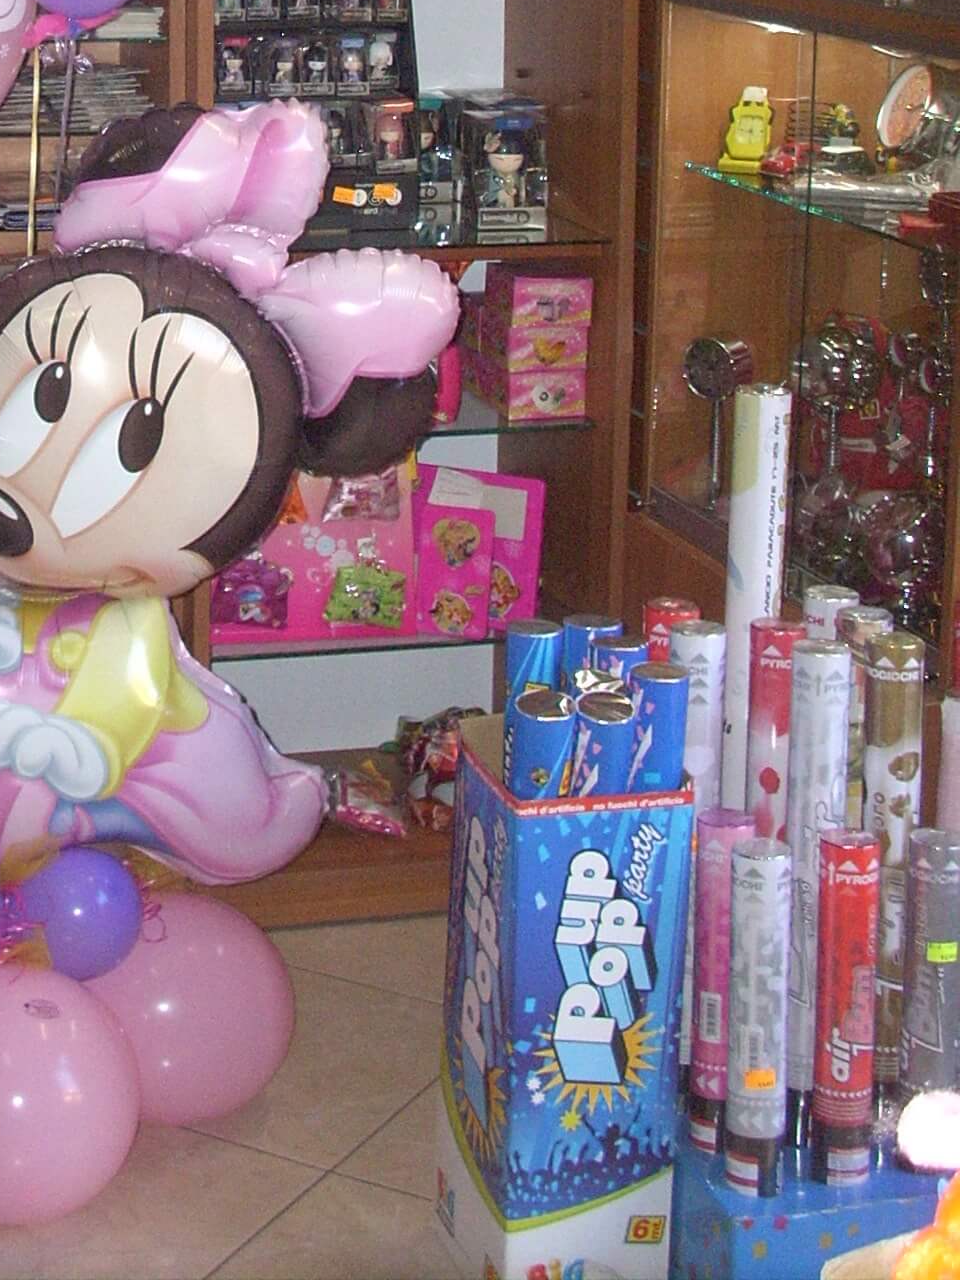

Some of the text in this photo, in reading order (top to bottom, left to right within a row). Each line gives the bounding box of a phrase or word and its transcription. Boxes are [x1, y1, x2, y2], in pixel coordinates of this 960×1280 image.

[620, 822, 666, 904] party
[826, 1026, 852, 1082] air
[633, 1219, 649, 1239] 6
